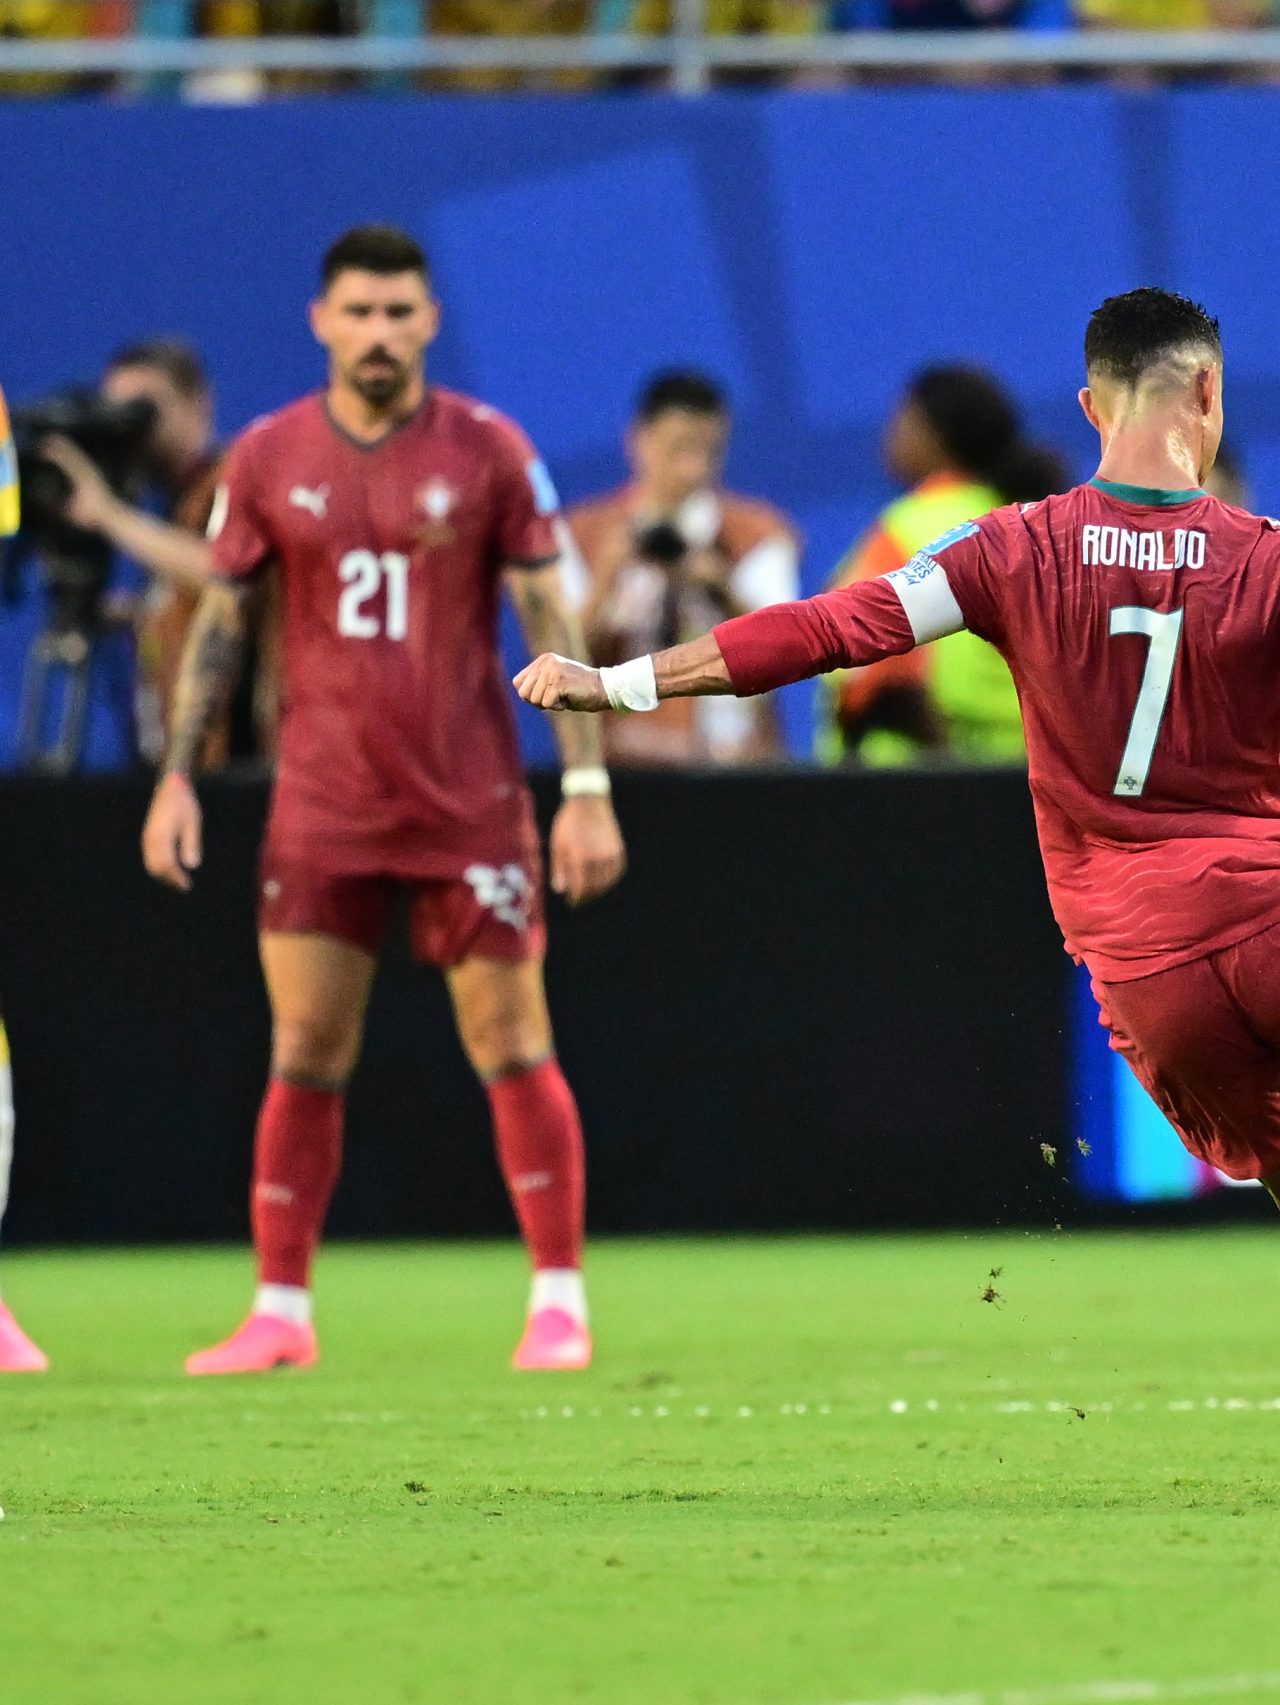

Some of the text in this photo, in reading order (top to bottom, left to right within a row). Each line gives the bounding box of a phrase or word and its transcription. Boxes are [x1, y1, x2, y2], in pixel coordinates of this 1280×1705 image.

[1082, 524, 1206, 571] RONALDO
[337, 548, 408, 641] 21
[1109, 604, 1184, 796] 7
